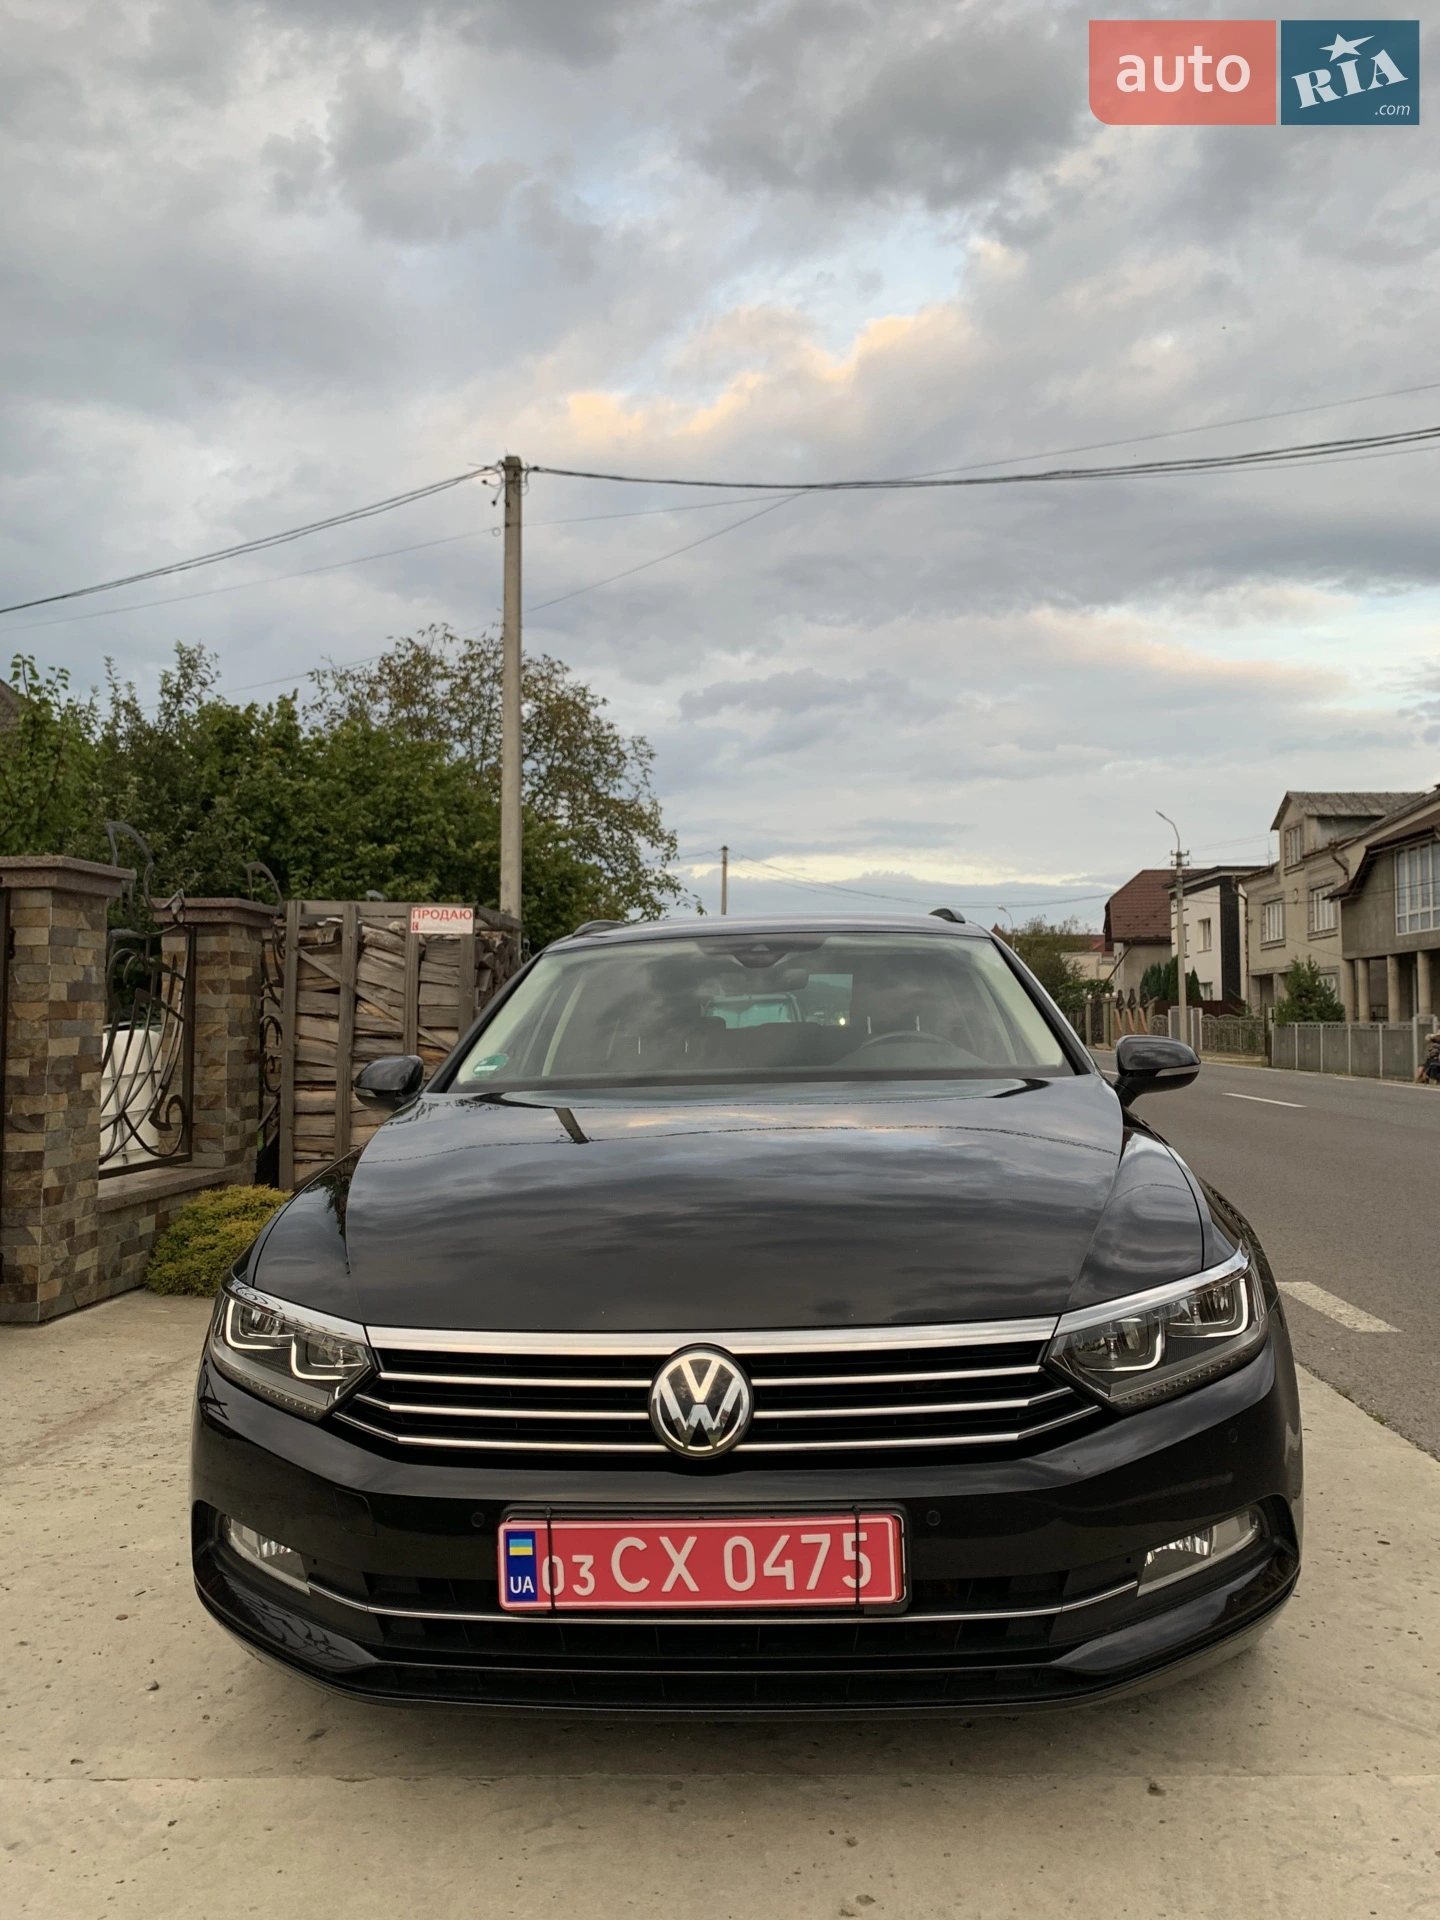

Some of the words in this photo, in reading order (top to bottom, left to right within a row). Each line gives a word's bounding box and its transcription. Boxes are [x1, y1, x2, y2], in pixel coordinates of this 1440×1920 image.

[412, 909, 473, 920] ПРОДАЮ
[541, 1554, 596, 1597] 03
[723, 1531, 873, 1592] 0475
[509, 1575, 535, 1595] UA
